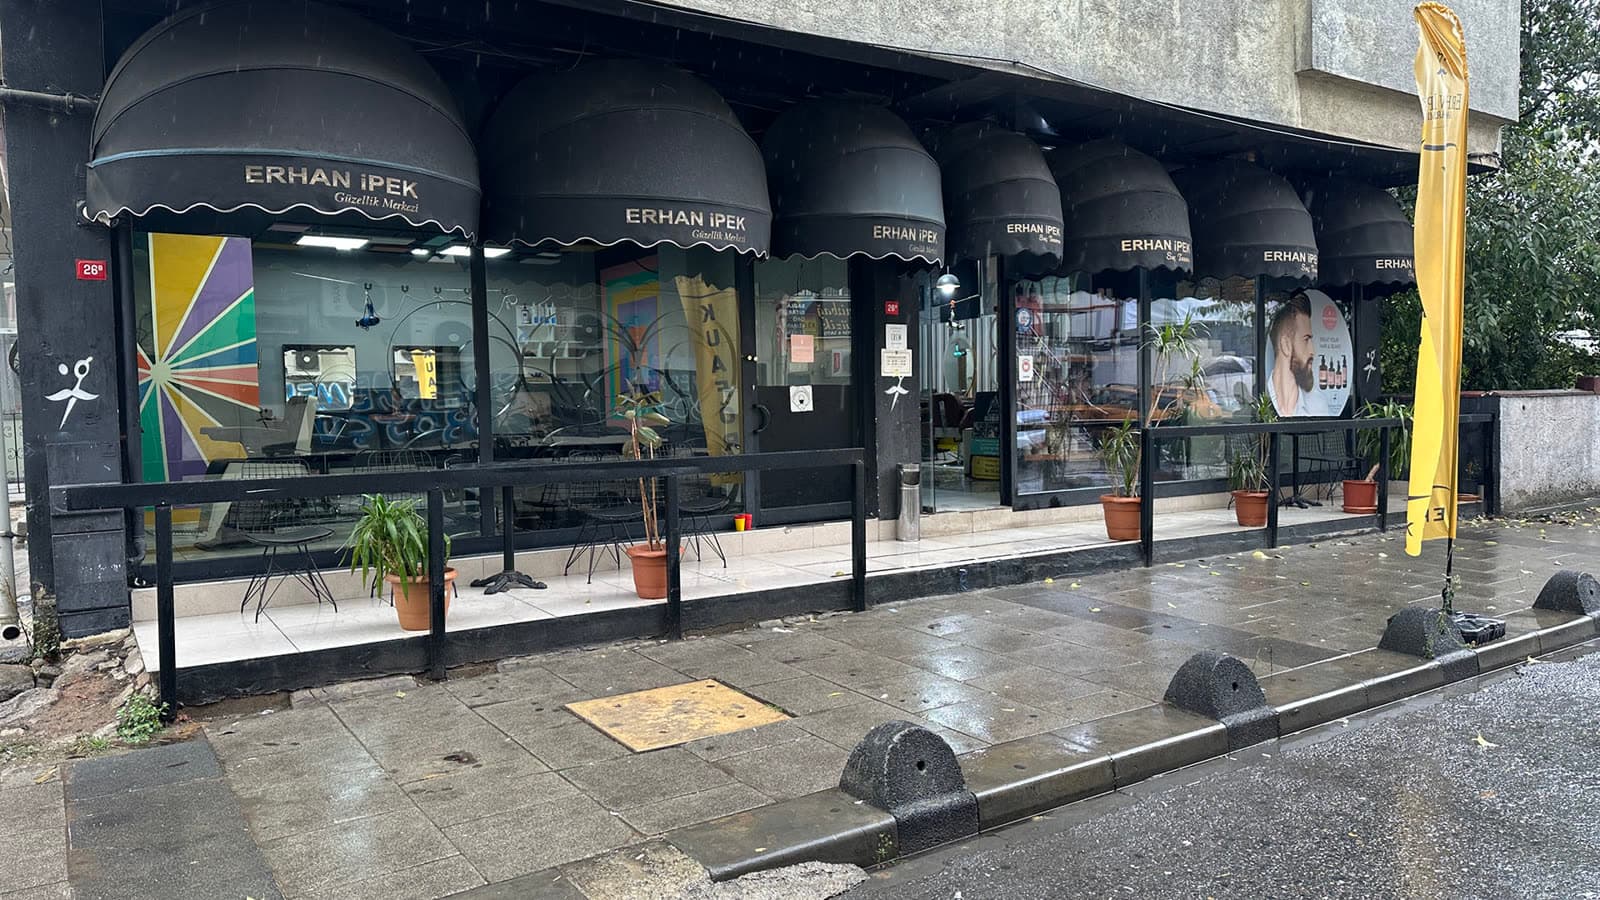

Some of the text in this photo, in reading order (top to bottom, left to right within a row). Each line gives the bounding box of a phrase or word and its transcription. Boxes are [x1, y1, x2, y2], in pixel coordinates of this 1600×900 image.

[245, 165, 350, 188] ERHAN
[334, 192, 419, 213] Güzellik Merkezi
[625, 208, 704, 226] ERHAN
[873, 225, 916, 241] ERHAN
[1007, 223, 1043, 233] ERHAN
[1121, 239, 1172, 251] ERHAN
[1264, 251, 1306, 263] ERHAN
[1375, 259, 1412, 269] ERHAN
